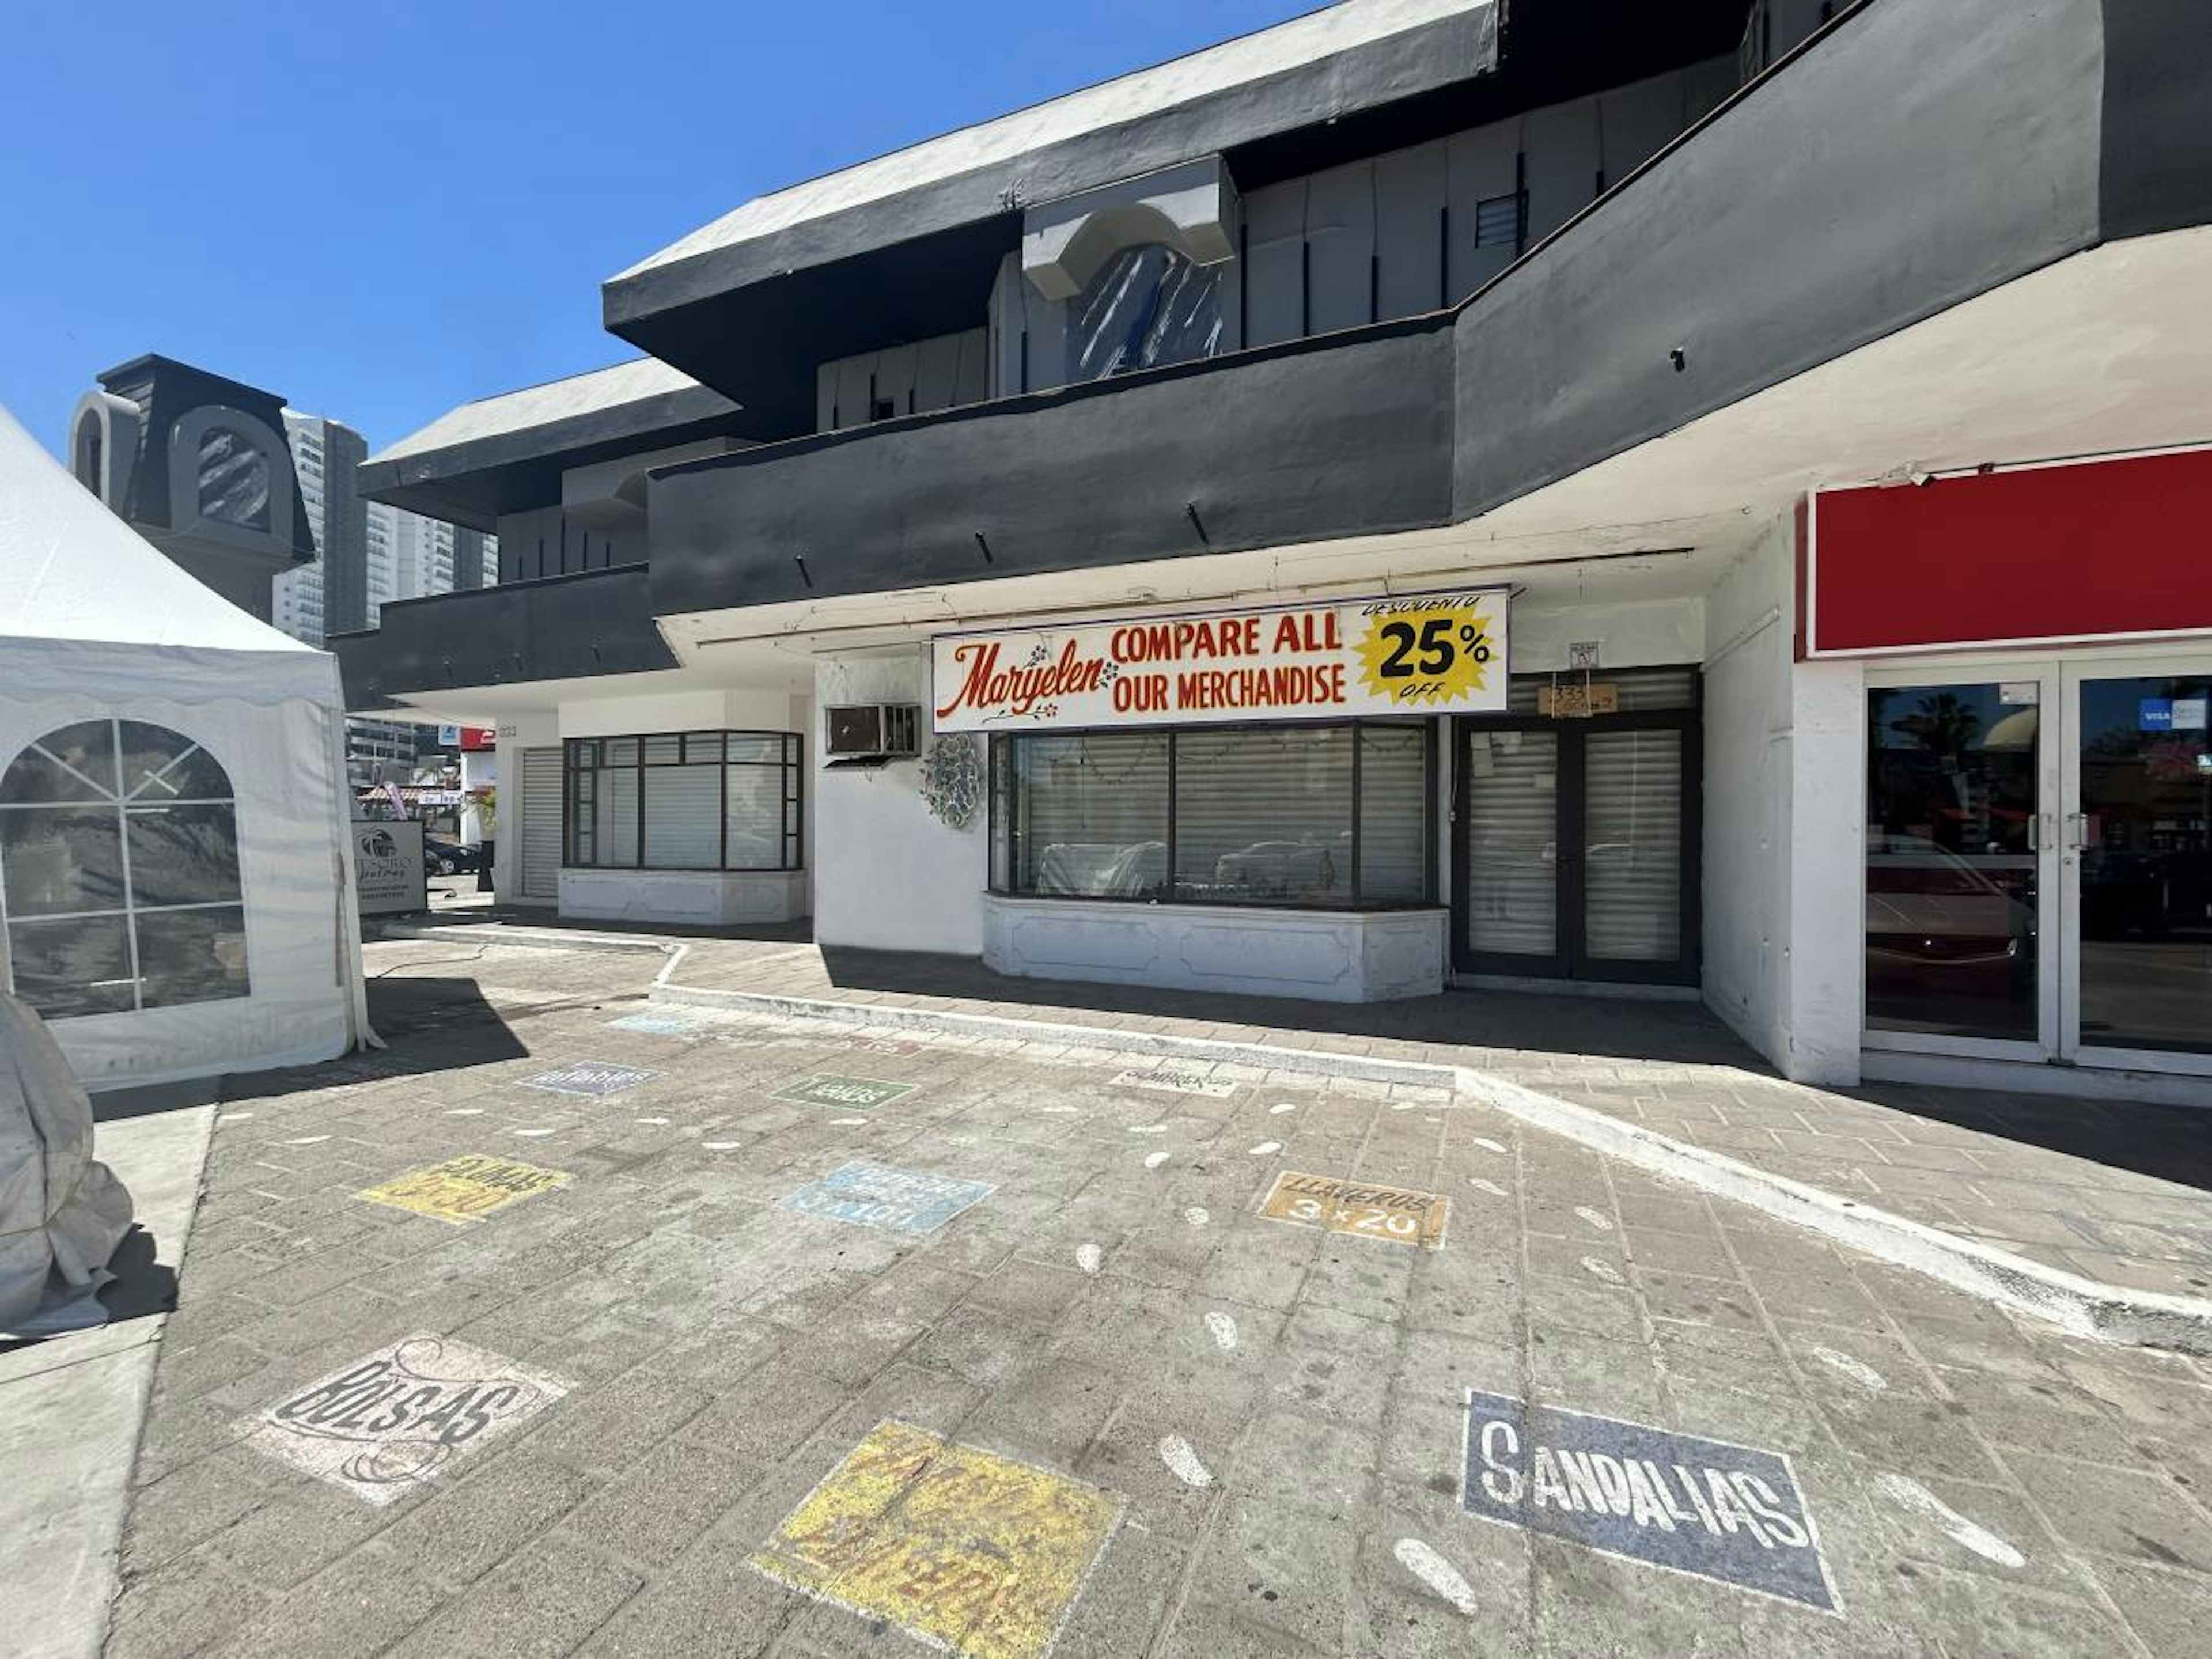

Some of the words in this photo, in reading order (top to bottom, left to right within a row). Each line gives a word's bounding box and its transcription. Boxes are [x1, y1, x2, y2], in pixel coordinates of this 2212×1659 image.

[1111, 618, 1260, 663] COMPARE
[1272, 612, 1343, 654] ALL
[1380, 619, 1490, 678] 25%
[936, 638, 1105, 718] Maryelen
[1113, 673, 1169, 713] OUR
[1177, 663, 1346, 710] MERCHANDISE
[1399, 681, 1446, 698] OFF
[2145, 712, 2171, 721] VISA
[275, 1360, 518, 1444] BOLSAS
[1480, 1420, 1810, 1550] SANDALIAS
